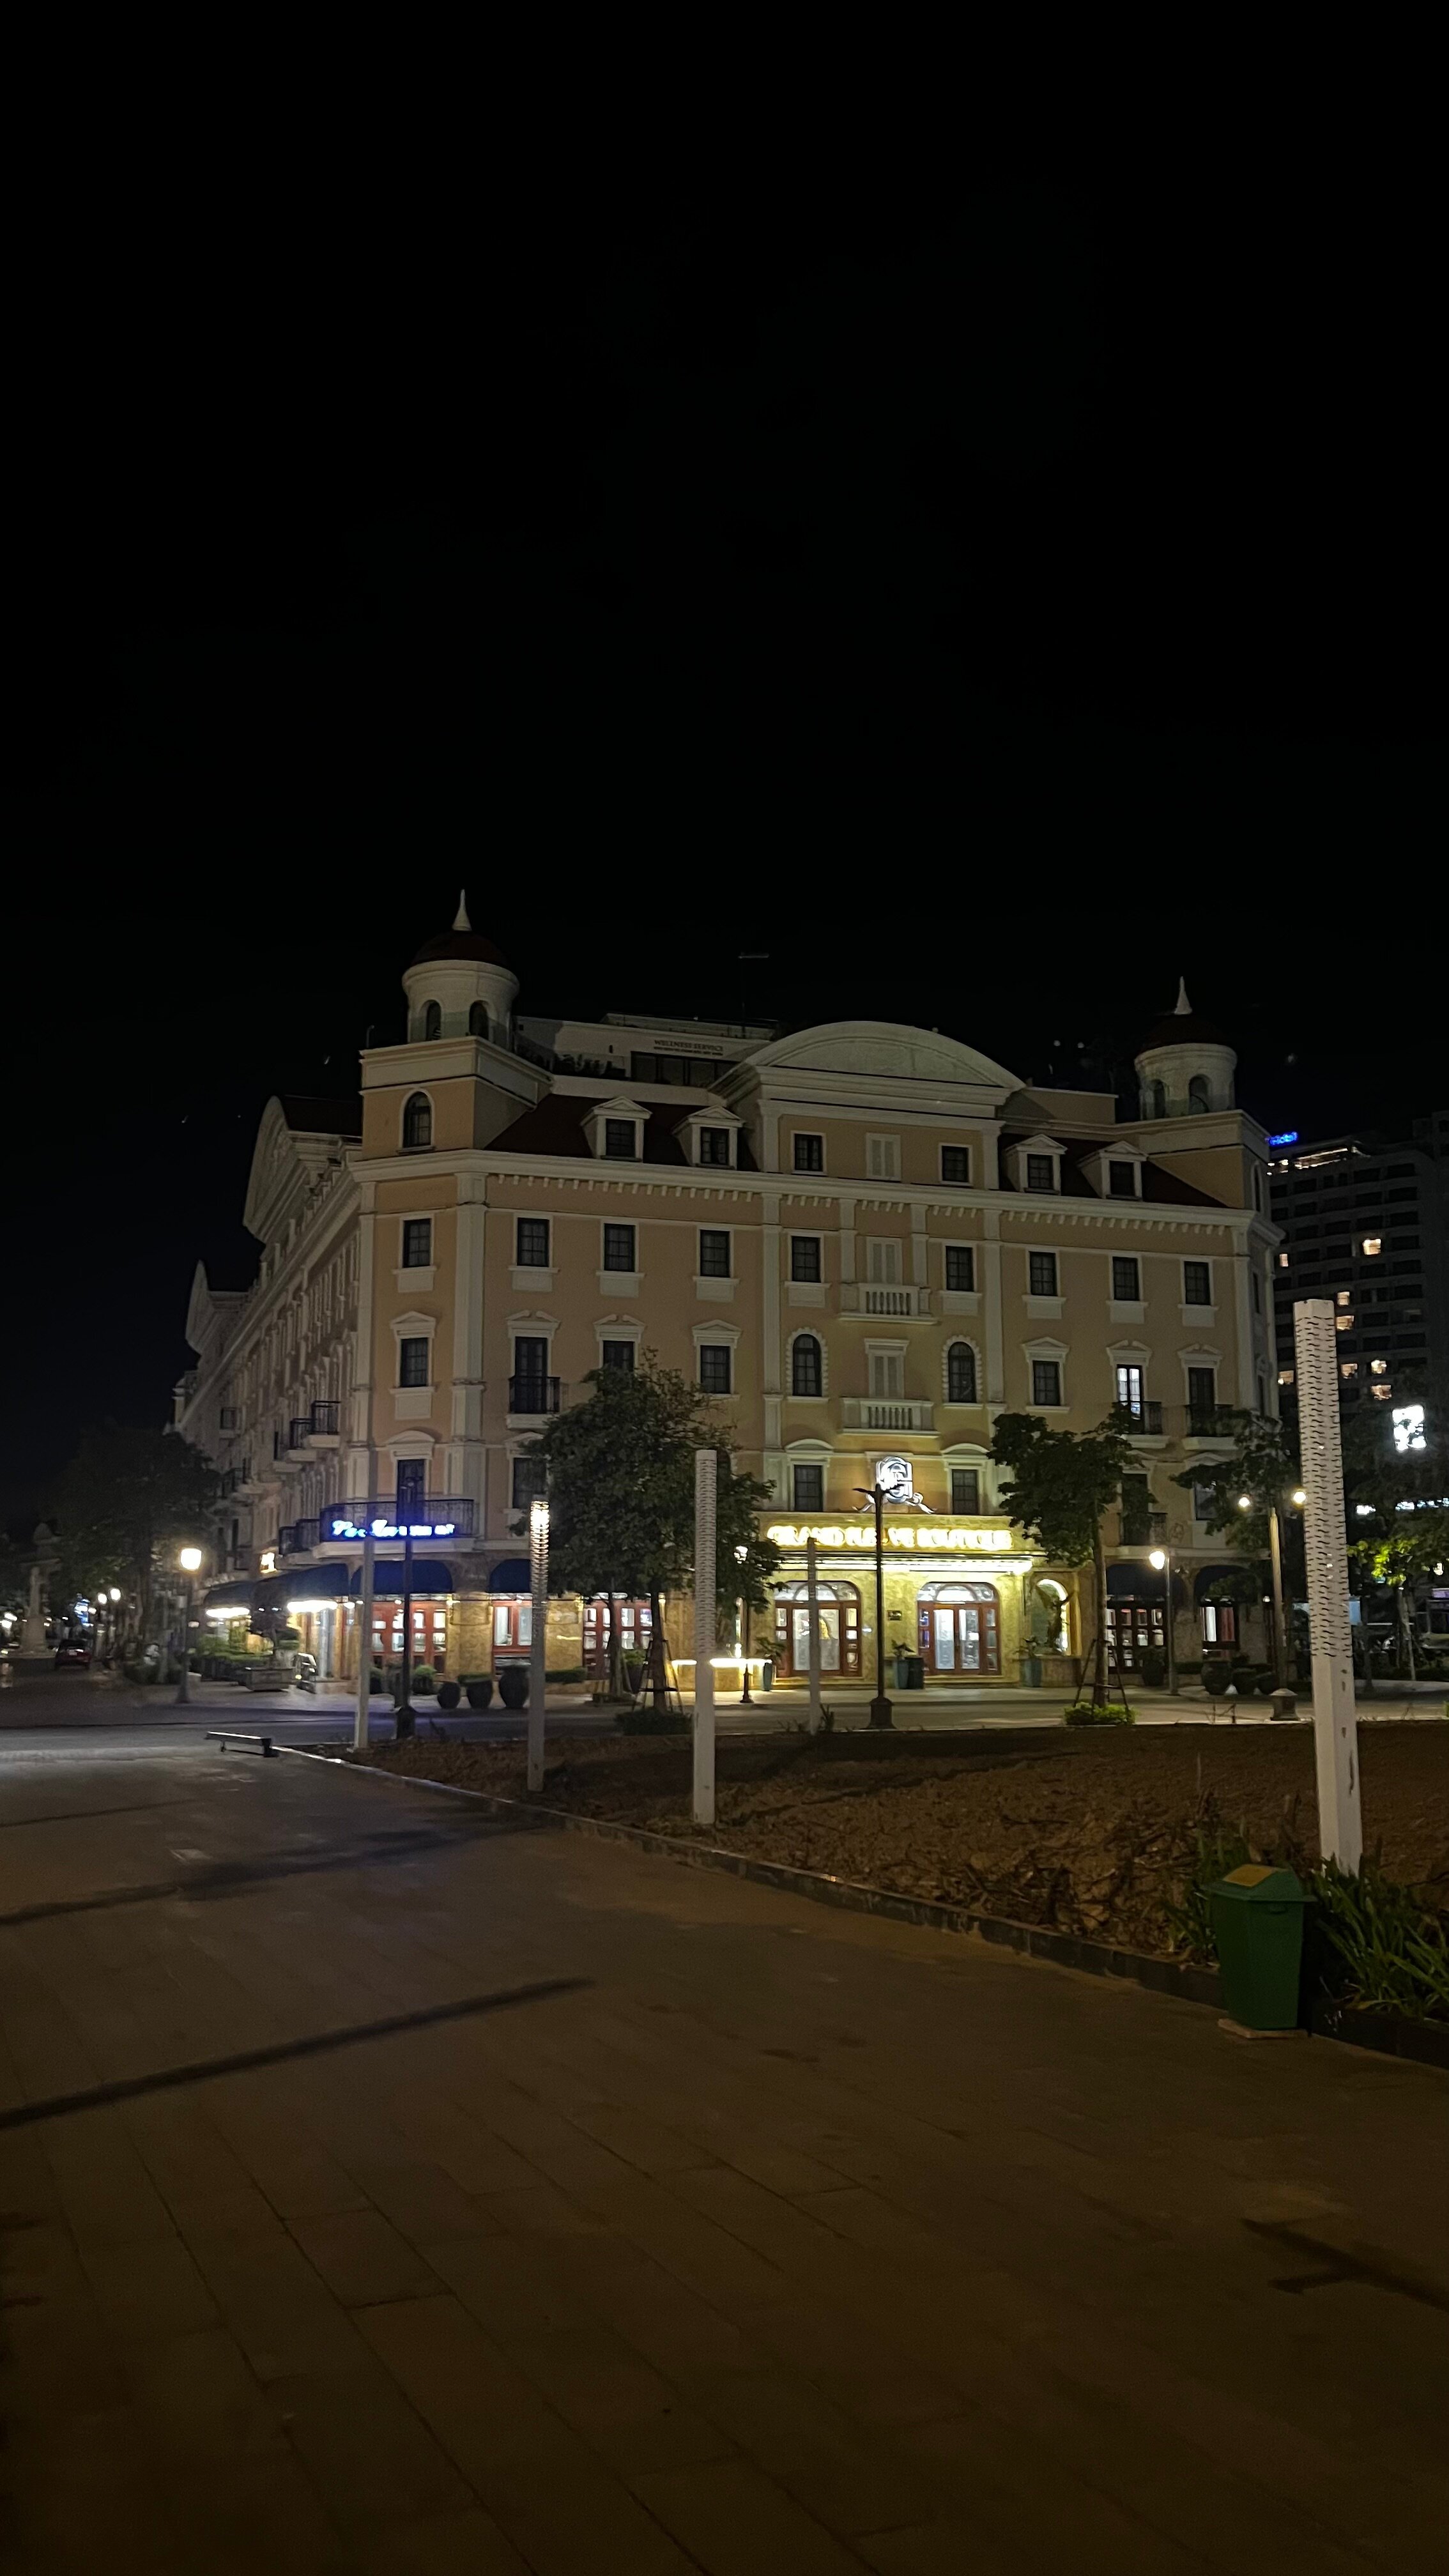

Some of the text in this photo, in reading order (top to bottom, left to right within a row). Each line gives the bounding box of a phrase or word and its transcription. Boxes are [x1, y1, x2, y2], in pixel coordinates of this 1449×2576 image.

[654, 1039, 692, 1048] WELLNESS
[694, 1043, 723, 1052] SERVICE
[916, 1528, 1013, 1550] BOUTIQUE
